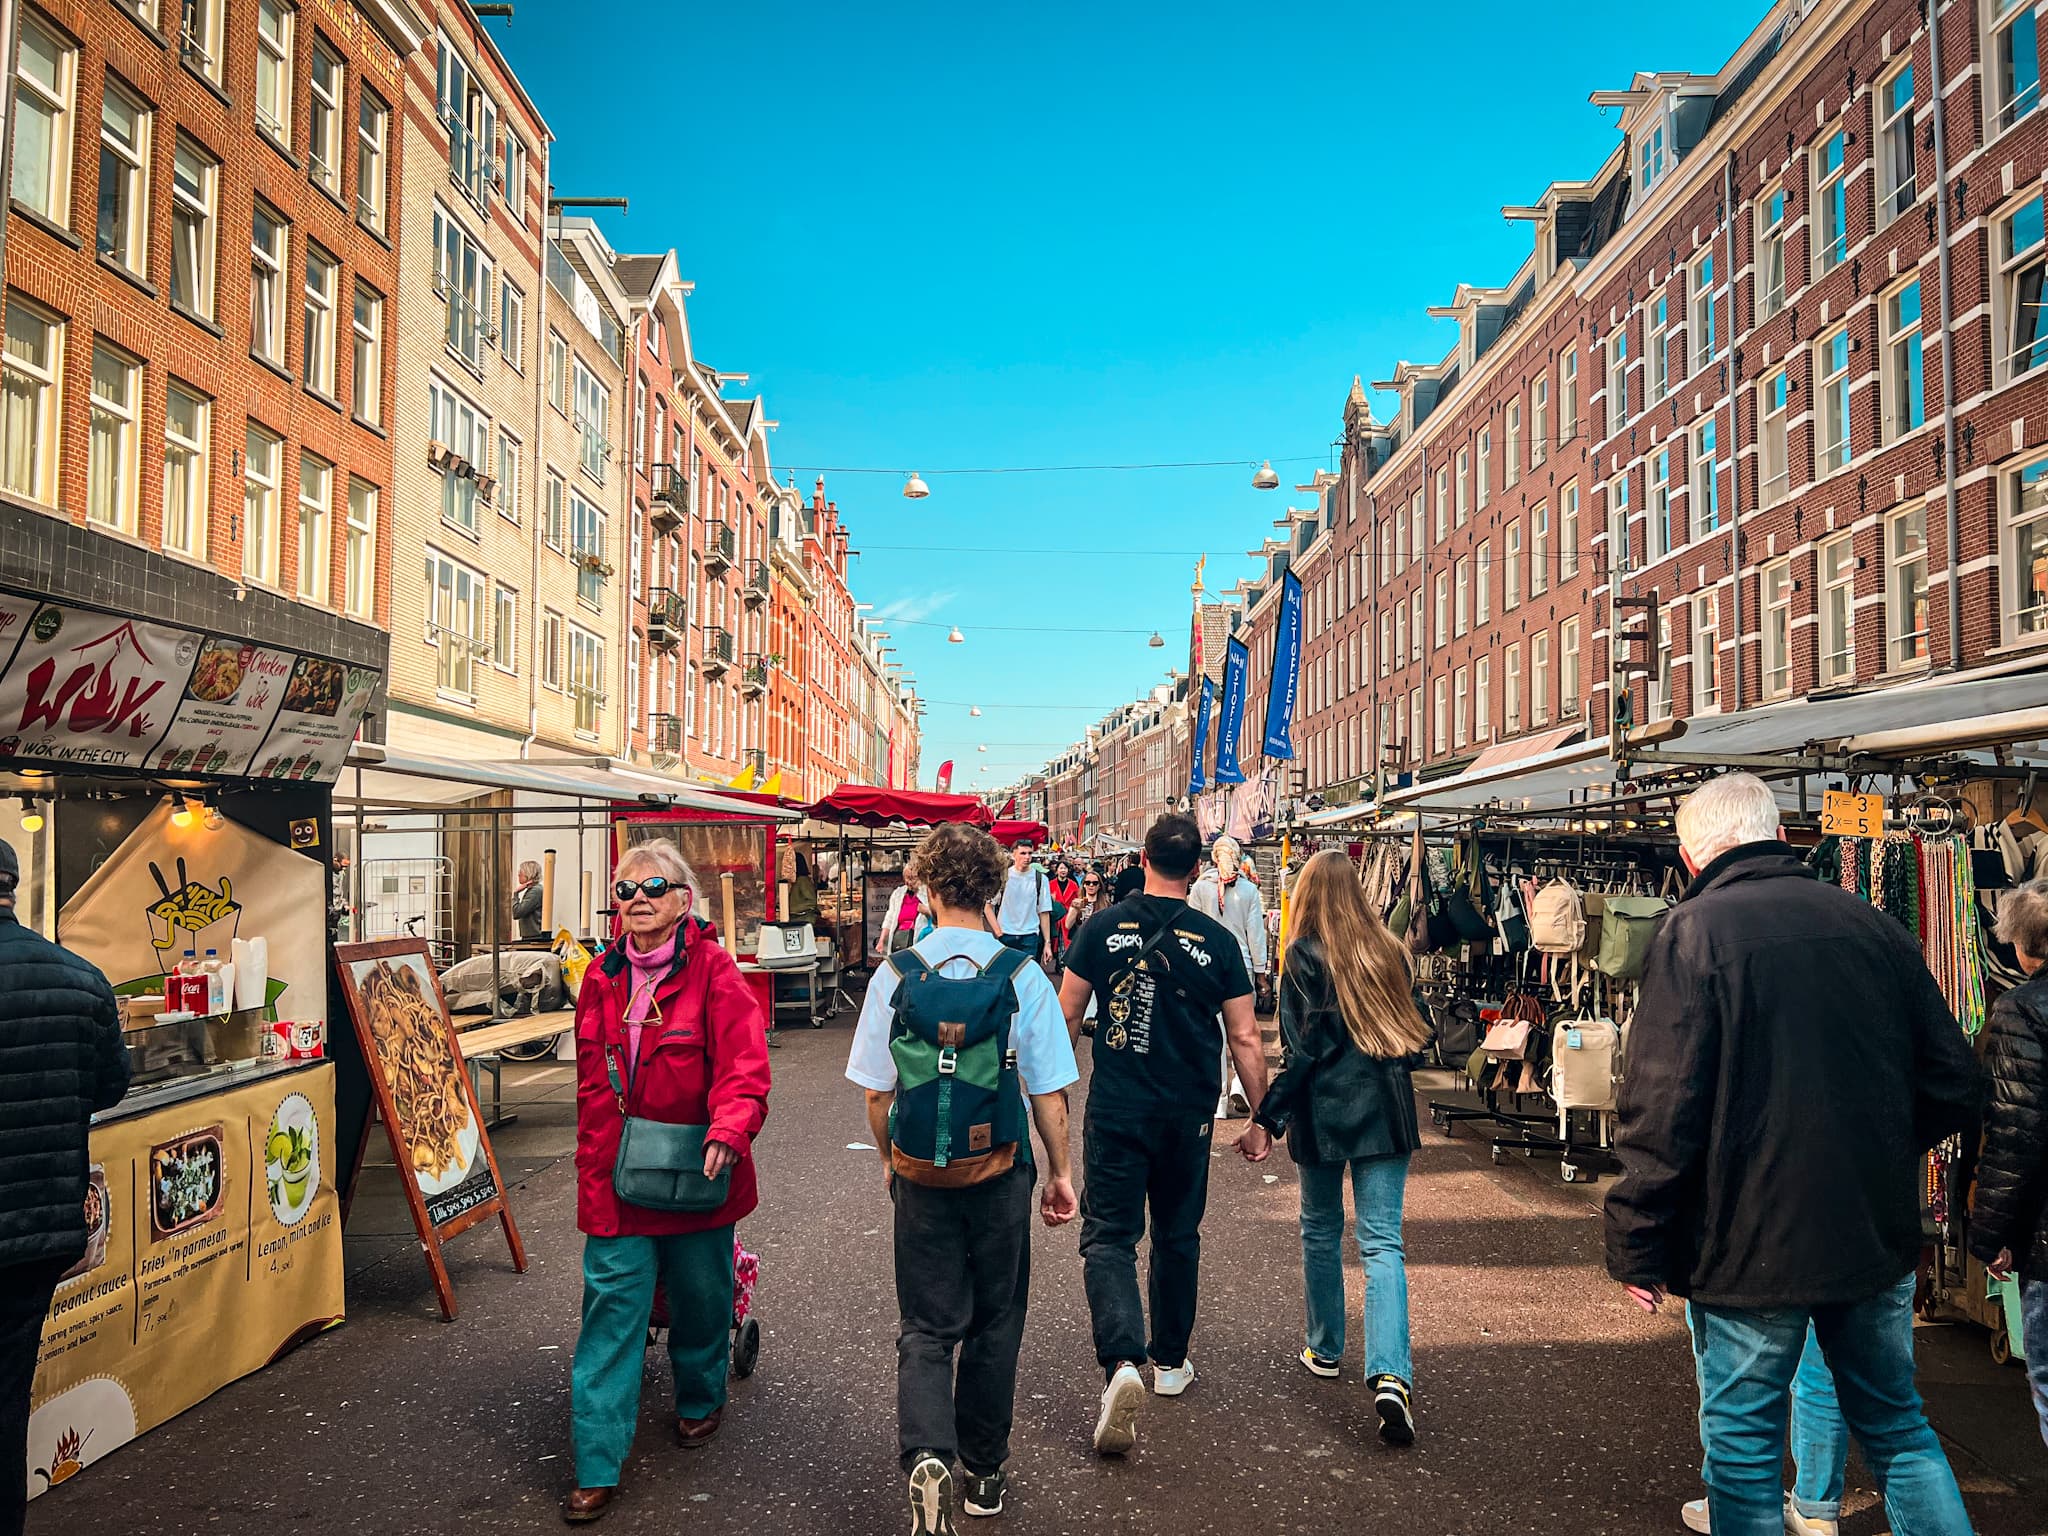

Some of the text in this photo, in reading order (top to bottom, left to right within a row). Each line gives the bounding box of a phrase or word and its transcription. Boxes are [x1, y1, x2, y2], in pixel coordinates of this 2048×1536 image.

[249, 650, 288, 677] Chicken
[17, 655, 166, 738] WOK
[22, 742, 131, 764] WOK IN THE CITY
[141, 1255, 165, 1276] Fries
[182, 1228, 227, 1263] parmesan
[258, 1213, 332, 1258] Lemon, mint and ice
[53, 1273, 128, 1322] peanut sauce
[47, 1329, 67, 1345] spring
[89, 1311, 104, 1327] spicy
[66, 1338, 78, 1351] and
